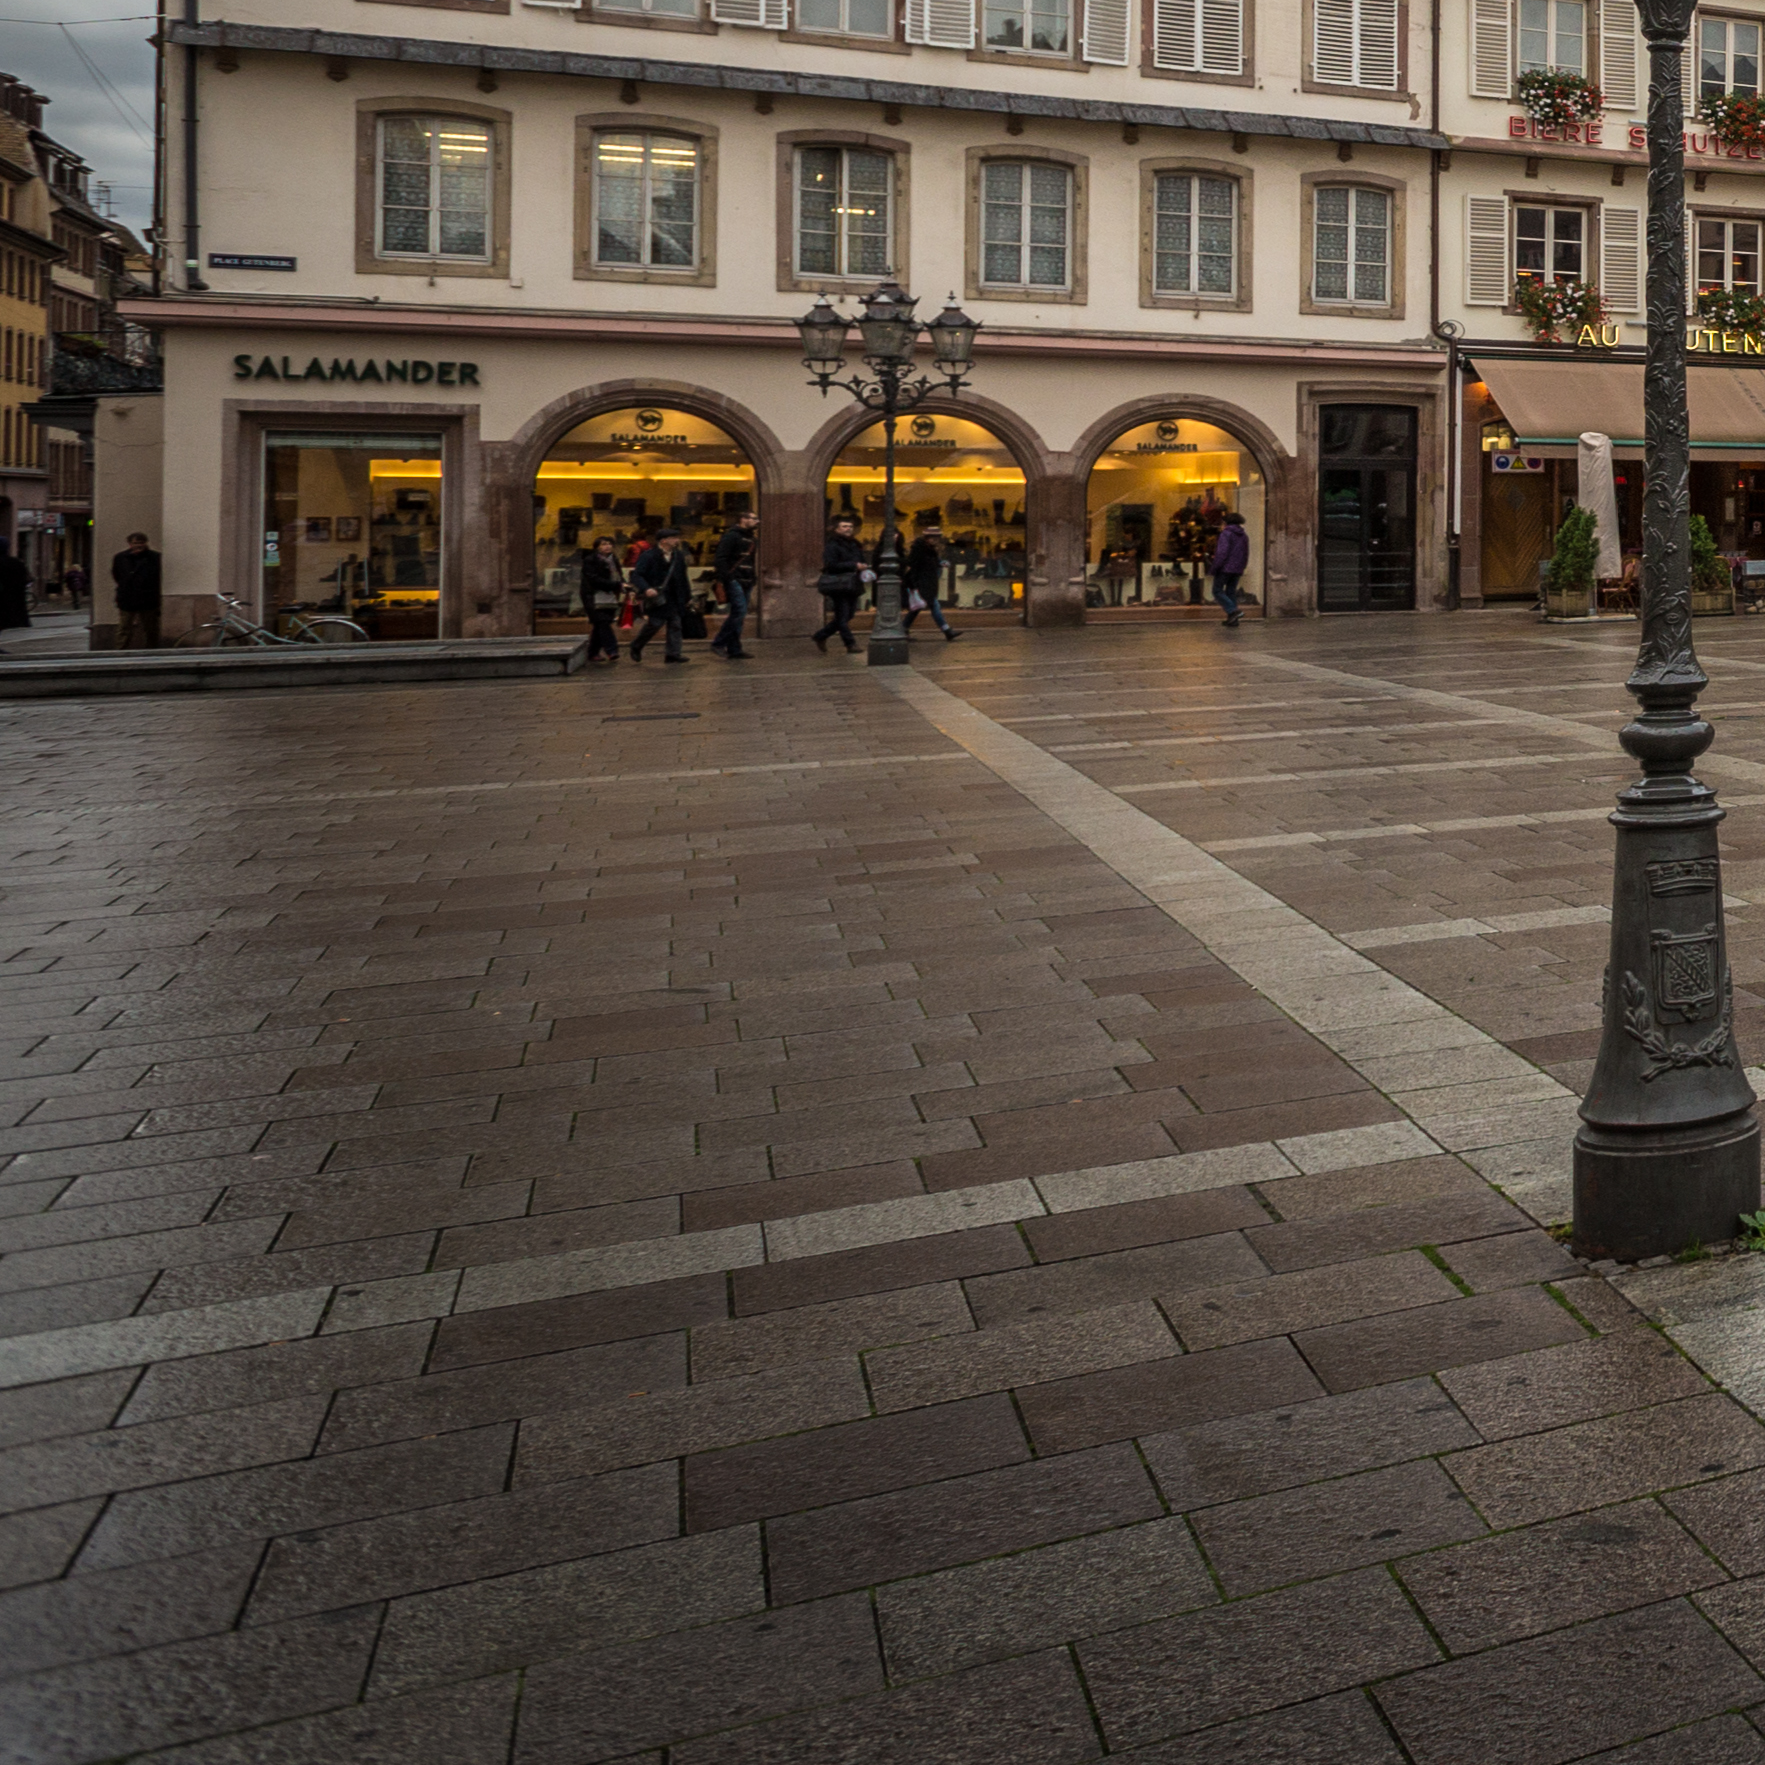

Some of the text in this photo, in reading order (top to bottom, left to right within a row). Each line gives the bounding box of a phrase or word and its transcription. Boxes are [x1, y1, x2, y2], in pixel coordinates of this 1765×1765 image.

[1509, 115, 1603, 144] BIERE
[1577, 324, 1620, 347] AU
[233, 354, 481, 385] SALAMANDER
[611, 433, 687, 444] SALAMANDER
[894, 439, 957, 448] ALAMANDER
[1136, 442, 1198, 452] SALAMANDER
